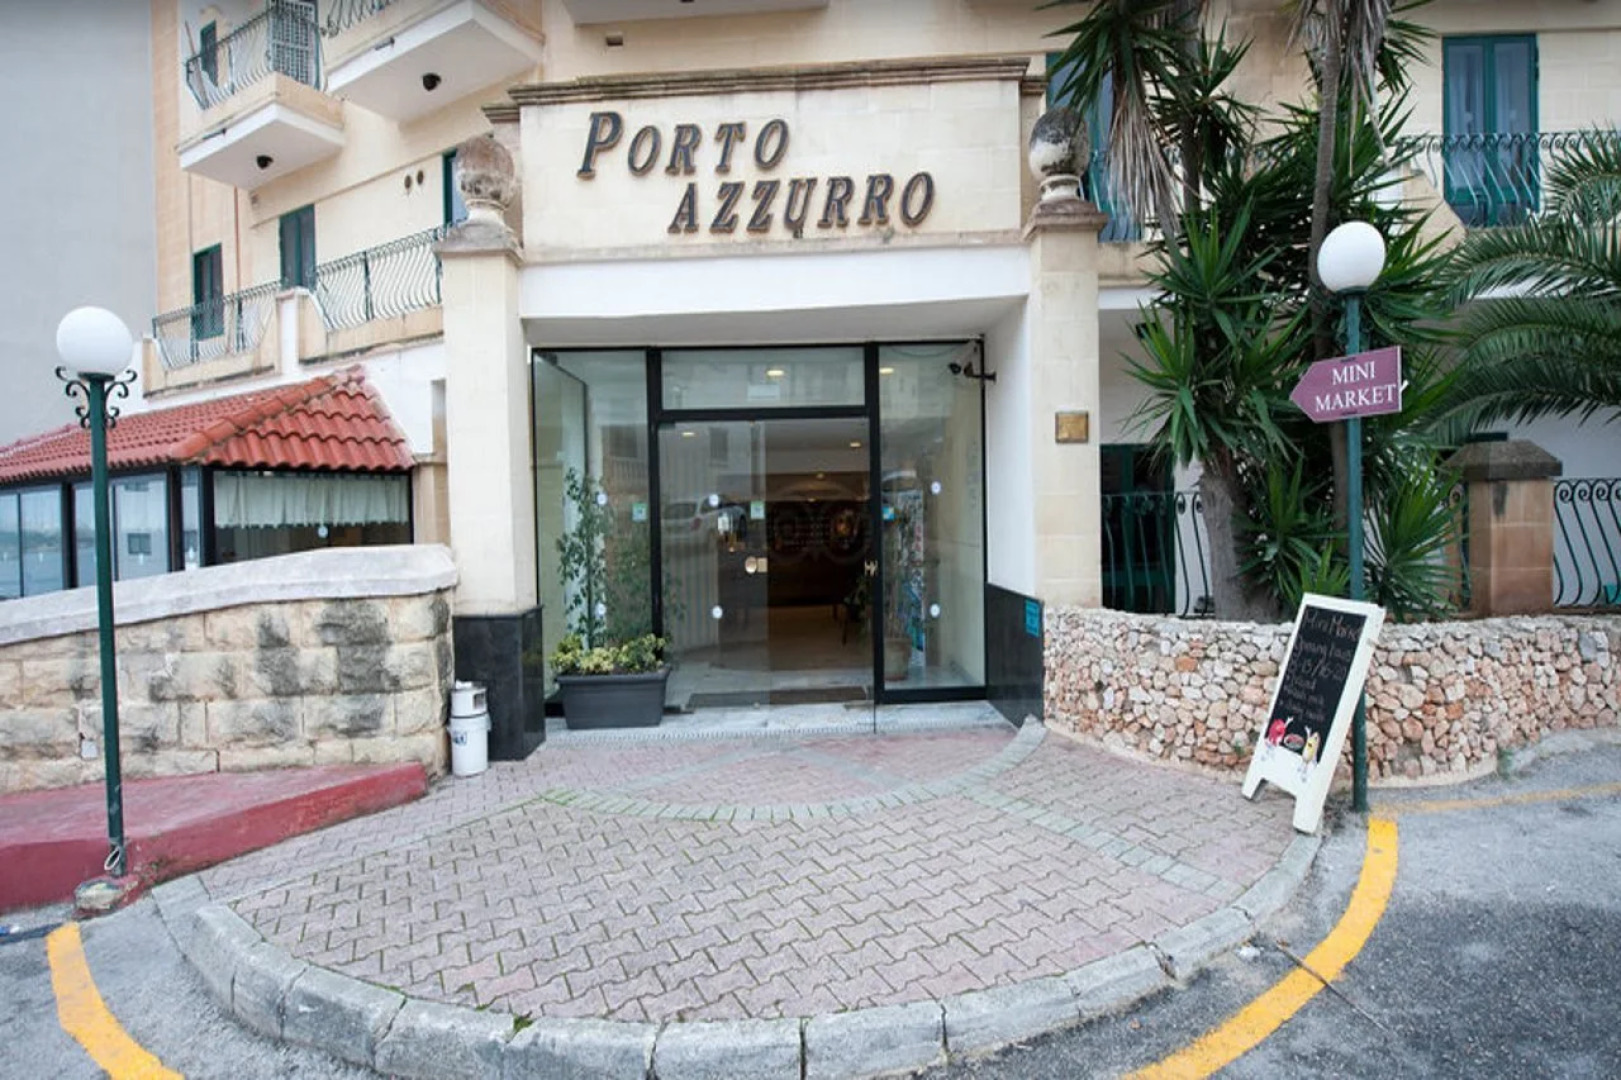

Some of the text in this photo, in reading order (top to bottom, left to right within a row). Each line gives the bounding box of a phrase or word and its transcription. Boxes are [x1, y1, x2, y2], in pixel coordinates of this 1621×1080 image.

[577, 111, 791, 179] PORTO
[668, 171, 935, 237] AZZURRO
[1332, 361, 1375, 385] MINI
[1315, 384, 1396, 412] MARKET
